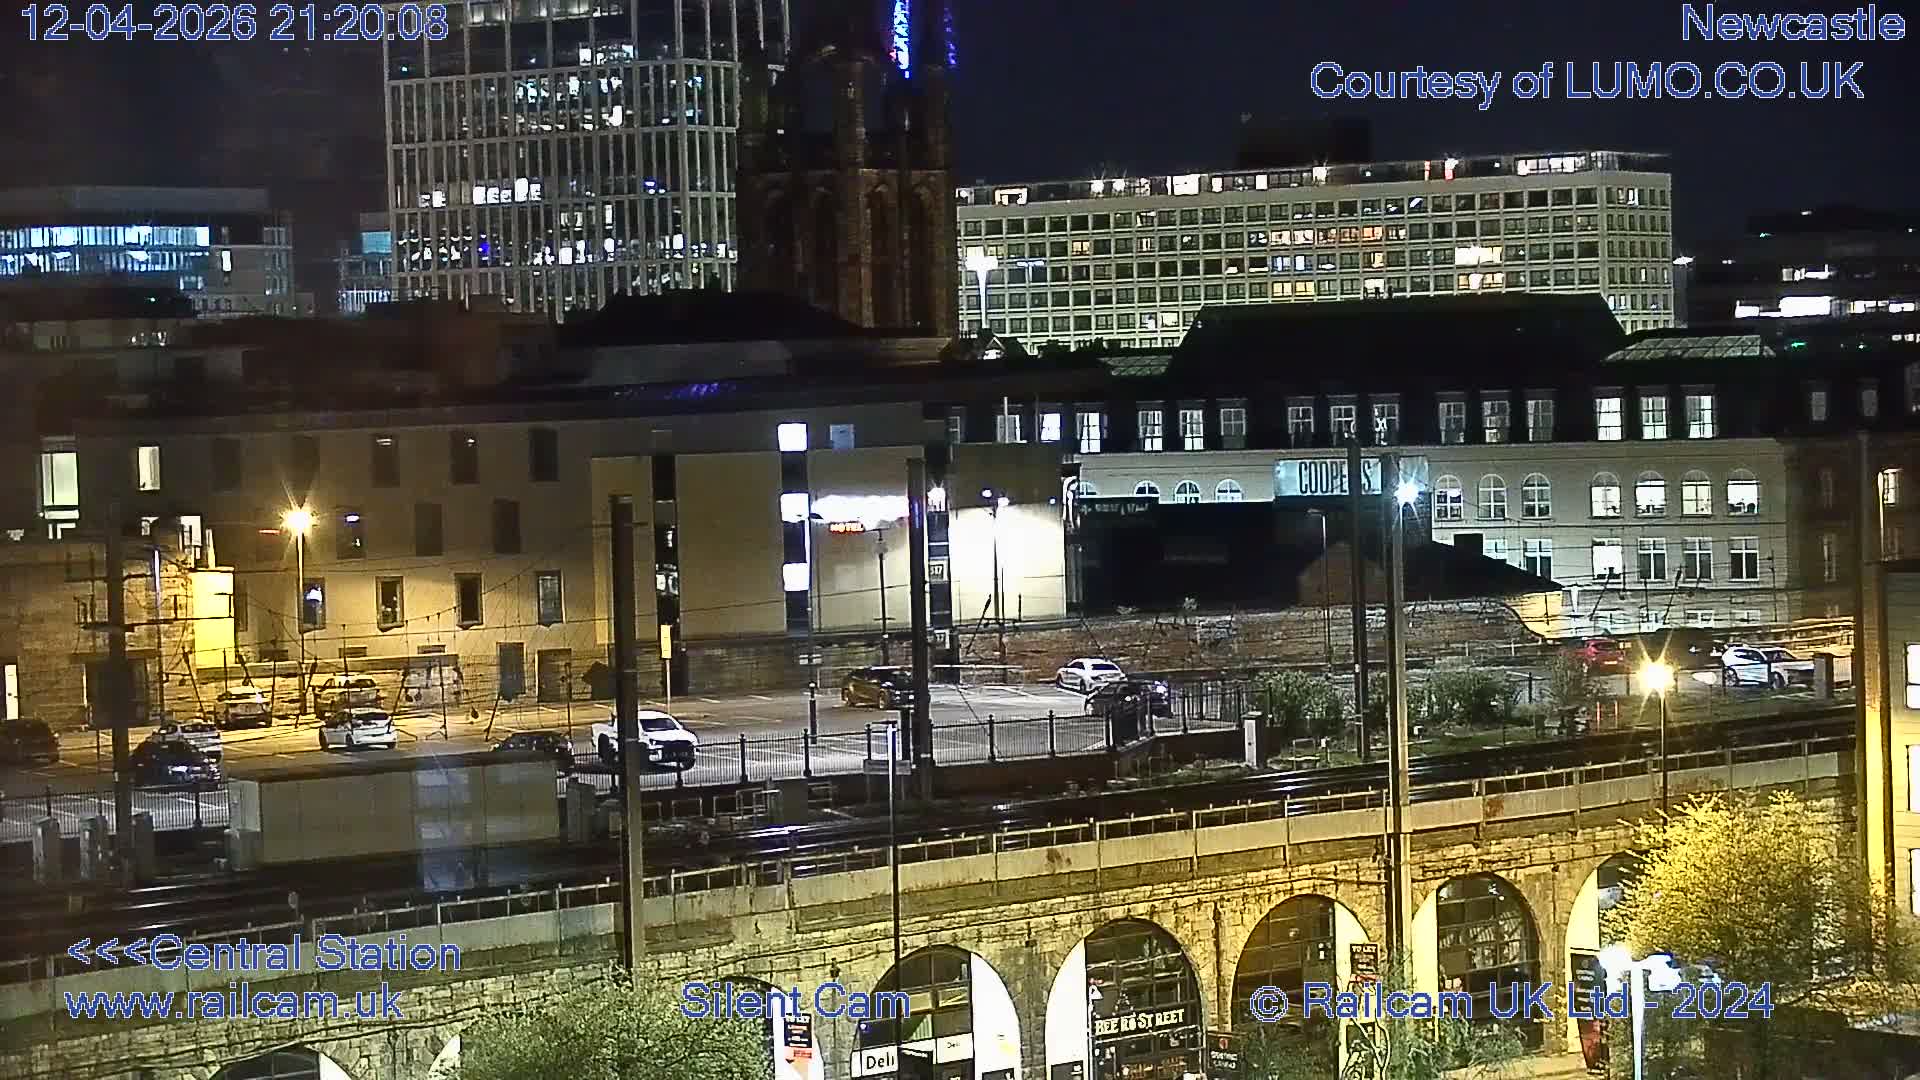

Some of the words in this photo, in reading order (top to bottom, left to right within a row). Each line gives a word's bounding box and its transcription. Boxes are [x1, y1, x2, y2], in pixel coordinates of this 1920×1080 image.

[1299, 460, 1372, 494] COOPES
[1094, 1015, 1129, 1036] BEER
[1137, 1008, 1185, 1030] STREET
[866, 1051, 895, 1070] Deli
